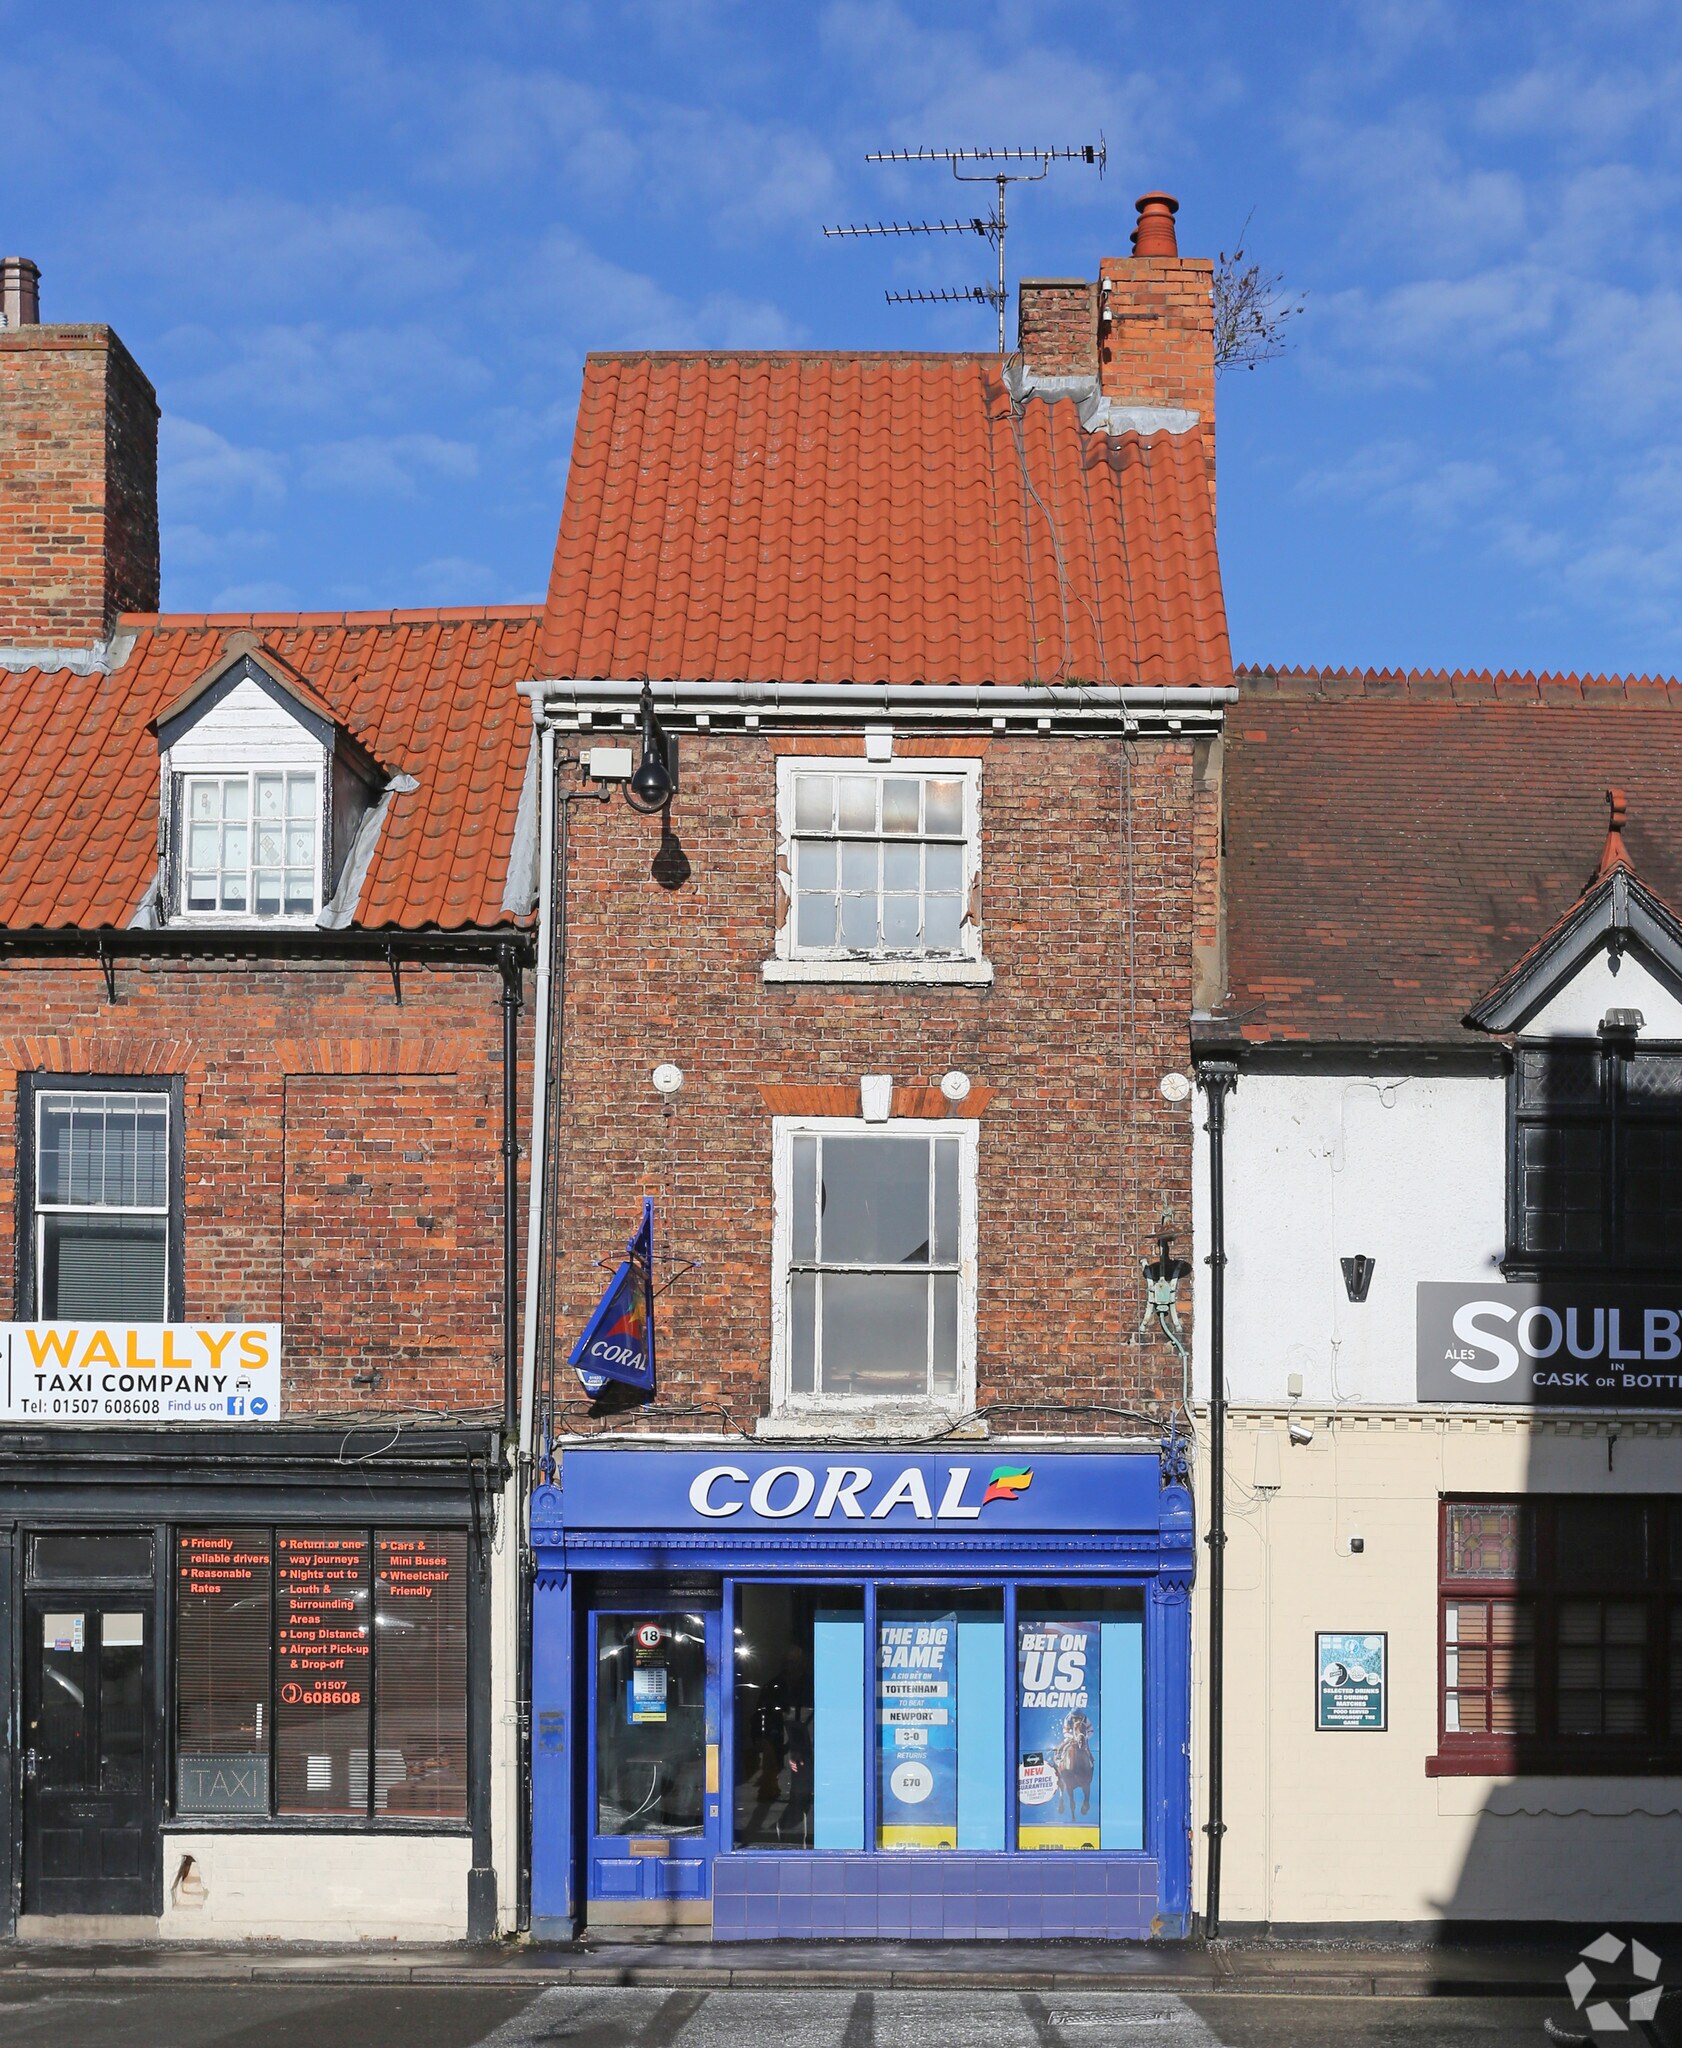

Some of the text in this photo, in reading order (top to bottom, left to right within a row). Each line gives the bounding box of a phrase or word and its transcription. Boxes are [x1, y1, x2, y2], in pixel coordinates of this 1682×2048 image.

[1450, 1301, 1682, 1384] SOULB
[25, 1330, 269, 1369] WALLYS
[1445, 1350, 1475, 1360] ALES
[591, 1341, 646, 1371] CORAL
[1611, 1363, 1625, 1371] IN
[34, 1374, 228, 1393] TAXI COMPANY
[1532, 1373, 1589, 1387] CASK
[1596, 1377, 1615, 1387] OR
[21, 1398, 160, 1414] Tel: 01507 608608
[168, 1400, 191, 1411] Find
[194, 1403, 206, 1411] us
[209, 1403, 223, 1411] on
[689, 1465, 982, 1519] CORAL
[191, 1538, 233, 1550] Friendly
[289, 1539, 325, 1549] Return
[342, 1540, 365, 1549] one-
[390, 1541, 426, 1550] Cars &
[191, 1553, 270, 1563] reliable drivers
[290, 1555, 360, 1566] way journeys
[390, 1556, 447, 1566] Mini Buses
[191, 1569, 252, 1579] Reasonable
[290, 1570, 358, 1580] Nights out to
[390, 1571, 449, 1581] Wheelchair
[190, 1583, 221, 1593] Rates
[290, 1584, 331, 1594] Louth &
[390, 1585, 433, 1597] Friendly
[289, 1599, 355, 1611] Surrounding
[290, 1614, 321, 1624] Areas
[290, 1629, 365, 1641] Long Distance
[642, 1630, 658, 1641] 18
[880, 1628, 948, 1645] THE BIG
[1021, 1634, 1087, 1651] BET ON
[290, 1644, 369, 1656] Airport Pick-up
[877, 1646, 945, 1668] GAME
[290, 1659, 345, 1670] & Drop-off
[1022, 1651, 1087, 1691] U.S.
[314, 1681, 347, 1690] 01507
[885, 1685, 938, 1694] TOTTENHAM
[303, 1692, 361, 1704] 608608
[1022, 1692, 1088, 1708] RACING
[889, 1712, 934, 1721] NEWPORT
[903, 1732, 920, 1741] 3-0
[1024, 1766, 1045, 1777] NEW
[190, 1769, 257, 1798] TAXI
[902, 1778, 921, 1787] £70
[1034, 1775, 1052, 1783] PRICE
